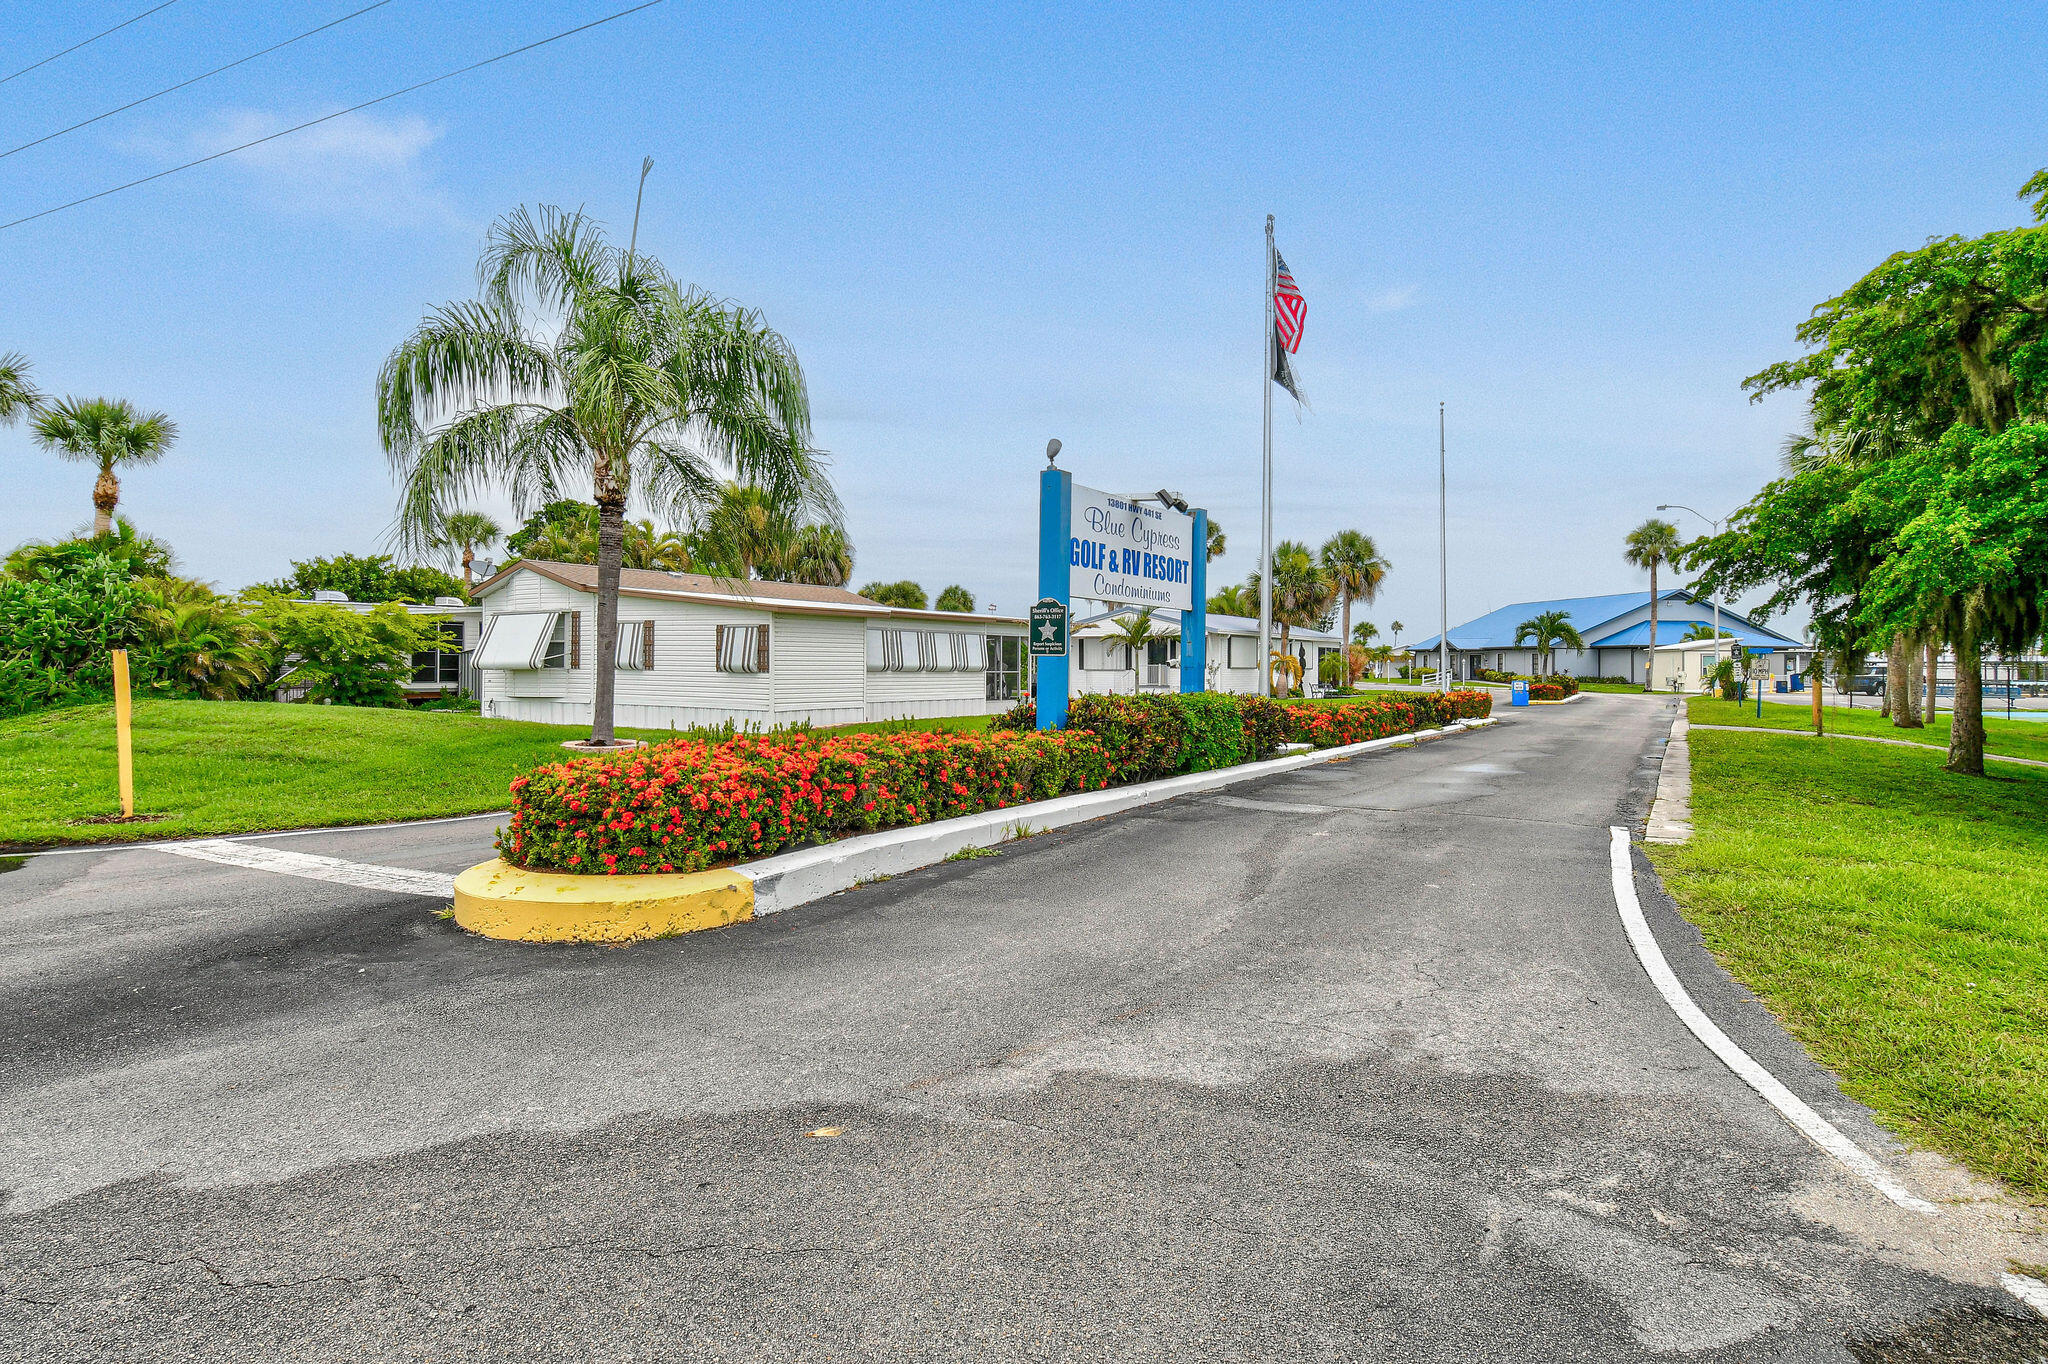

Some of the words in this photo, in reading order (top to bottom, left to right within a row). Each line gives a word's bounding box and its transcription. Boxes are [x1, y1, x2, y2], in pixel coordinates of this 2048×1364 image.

[1107, 498, 1127, 510] 13801
[1128, 503, 1142, 514] HWY
[1144, 508, 1154, 518] 441
[1155, 512, 1162, 520] SE
[1084, 506, 1125, 537] Blue
[1132, 517, 1180, 550] Cypress
[1070, 537, 1106, 571] GOLF
[1109, 549, 1119, 573] &
[1122, 548, 1140, 576] RV
[1144, 552, 1189, 584] RESORT
[1094, 573, 1171, 603] Condominiums
